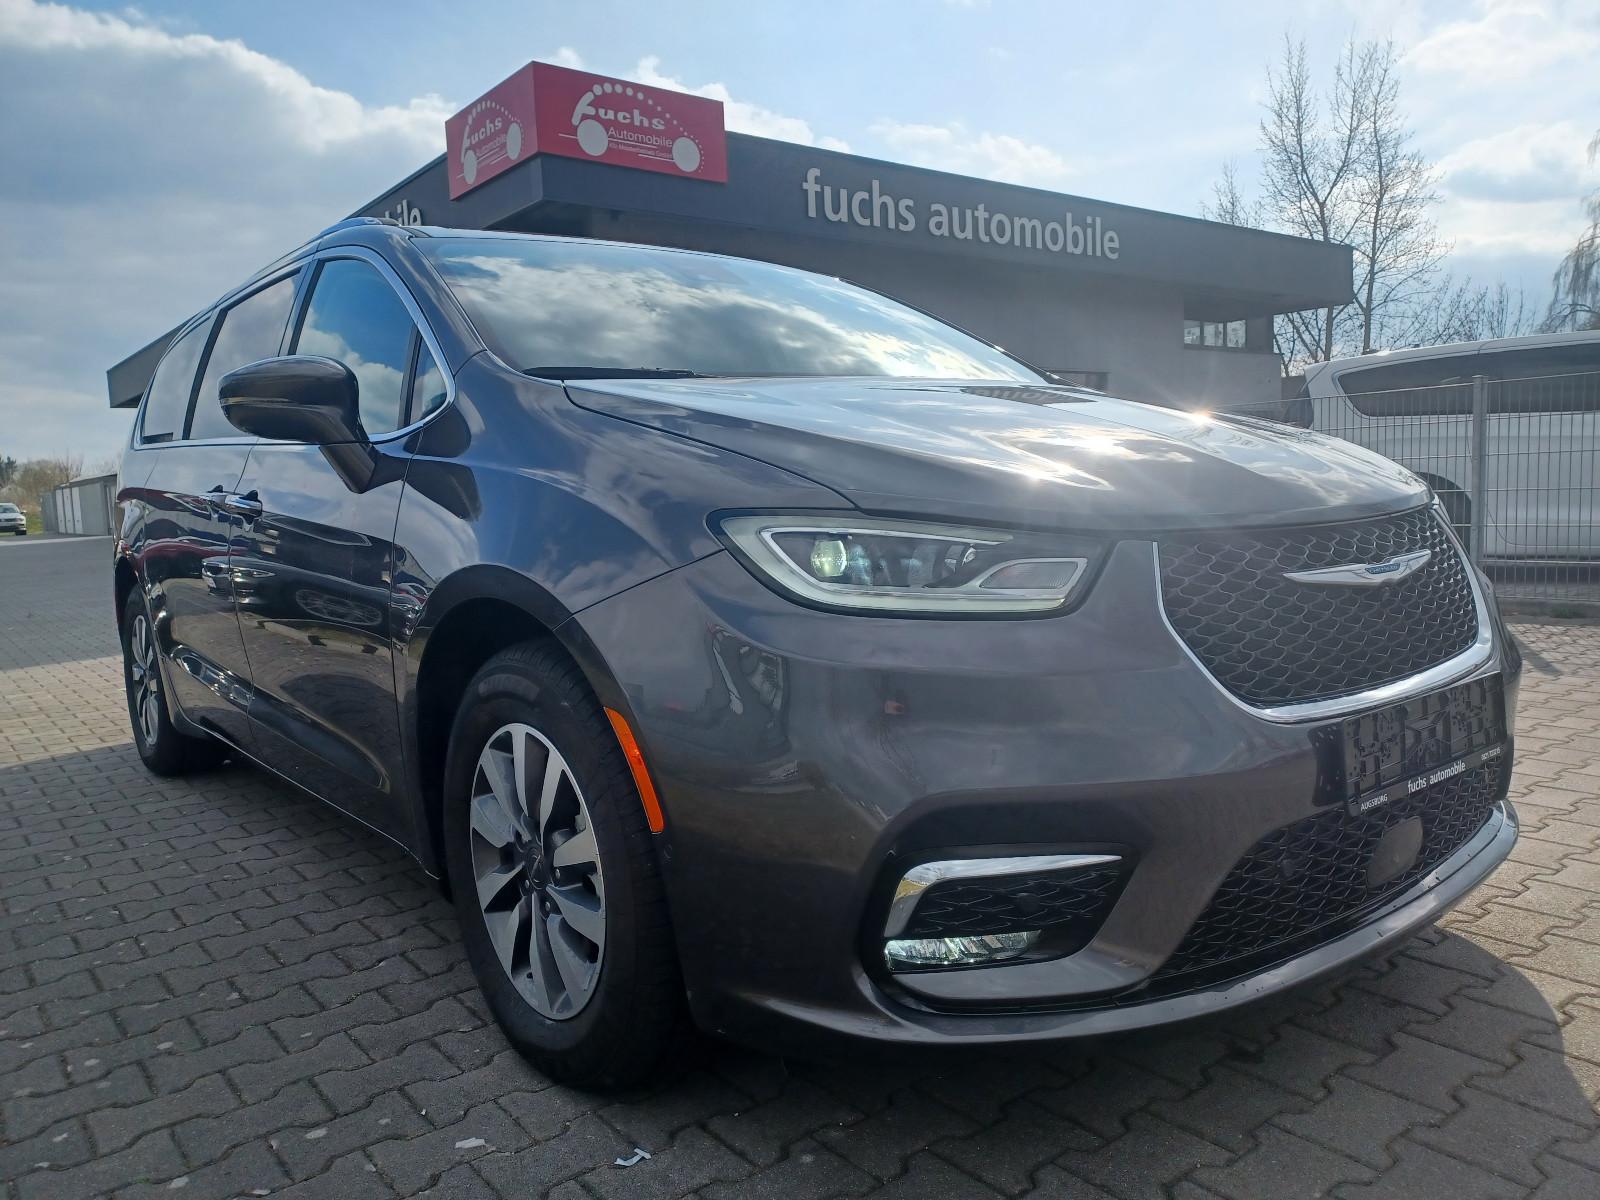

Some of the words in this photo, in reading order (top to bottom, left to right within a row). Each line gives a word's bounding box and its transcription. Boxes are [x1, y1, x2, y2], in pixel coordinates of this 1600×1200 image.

[607, 126, 674, 148] Automobile
[802, 167, 916, 232] fuchs
[928, 202, 1121, 260] automobile
[1407, 778, 1427, 794] fuchs
[1429, 759, 1466, 785] automobile
